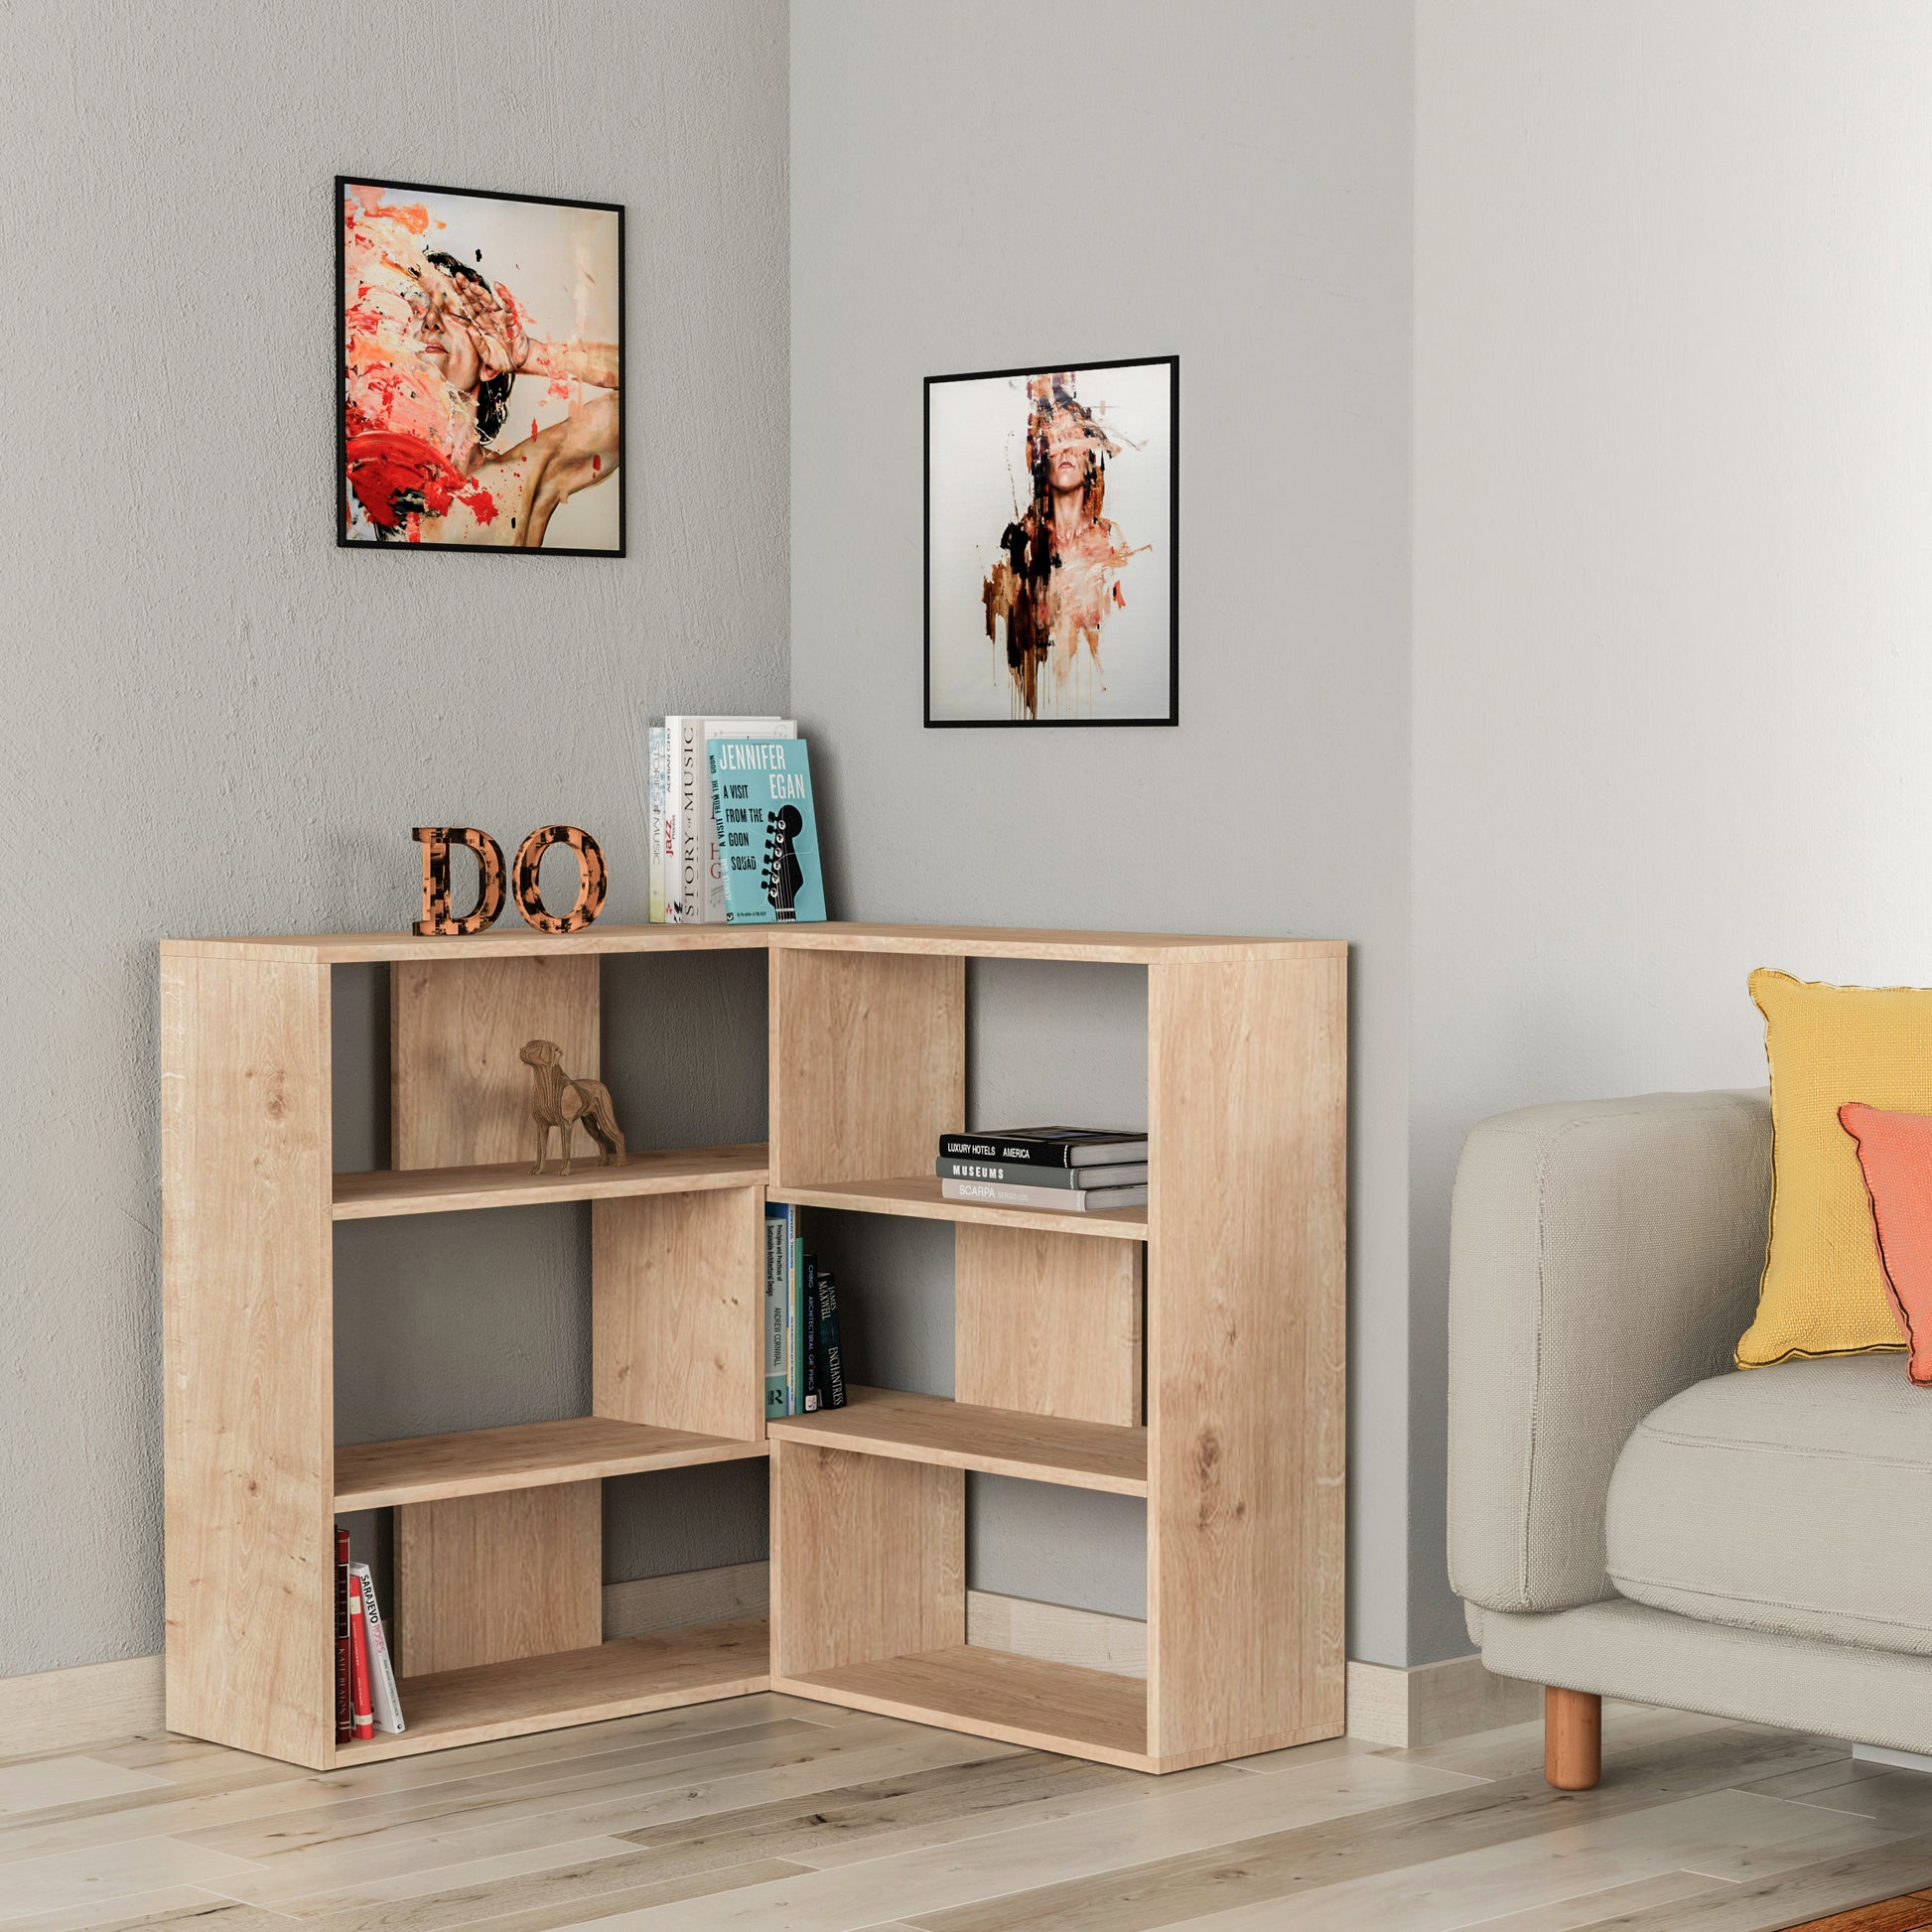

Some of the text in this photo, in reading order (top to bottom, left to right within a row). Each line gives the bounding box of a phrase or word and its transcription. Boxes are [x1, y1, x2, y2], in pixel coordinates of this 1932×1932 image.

[719, 745, 786, 770] JENNIFER
[684, 727, 694, 811] MUSIC
[723, 784, 749, 799] A VISIT
[768, 773, 805, 799] EGAN
[713, 793, 722, 814] FROM
[726, 808, 763, 823] FROM THE
[716, 818, 725, 840] VISIT
[728, 832, 750, 847] GOON
[684, 832, 695, 917] STORY
[731, 856, 757, 871] SQUAD
[412, 824, 608, 936] DO
[947, 1142, 1031, 1160] LUXURY HOTELS AMERICA
[952, 1165, 1004, 1179] MUSEUMS
[959, 1184, 996, 1198] SCARPA
[765, 1281, 774, 1298] Design
[818, 1280, 831, 1321] MAXWELL
[827, 1286, 837, 1311] JAMES
[828, 1346, 844, 1405] ENCHANTRESS
[360, 1574, 386, 1653] SARAJEVO ROSES
